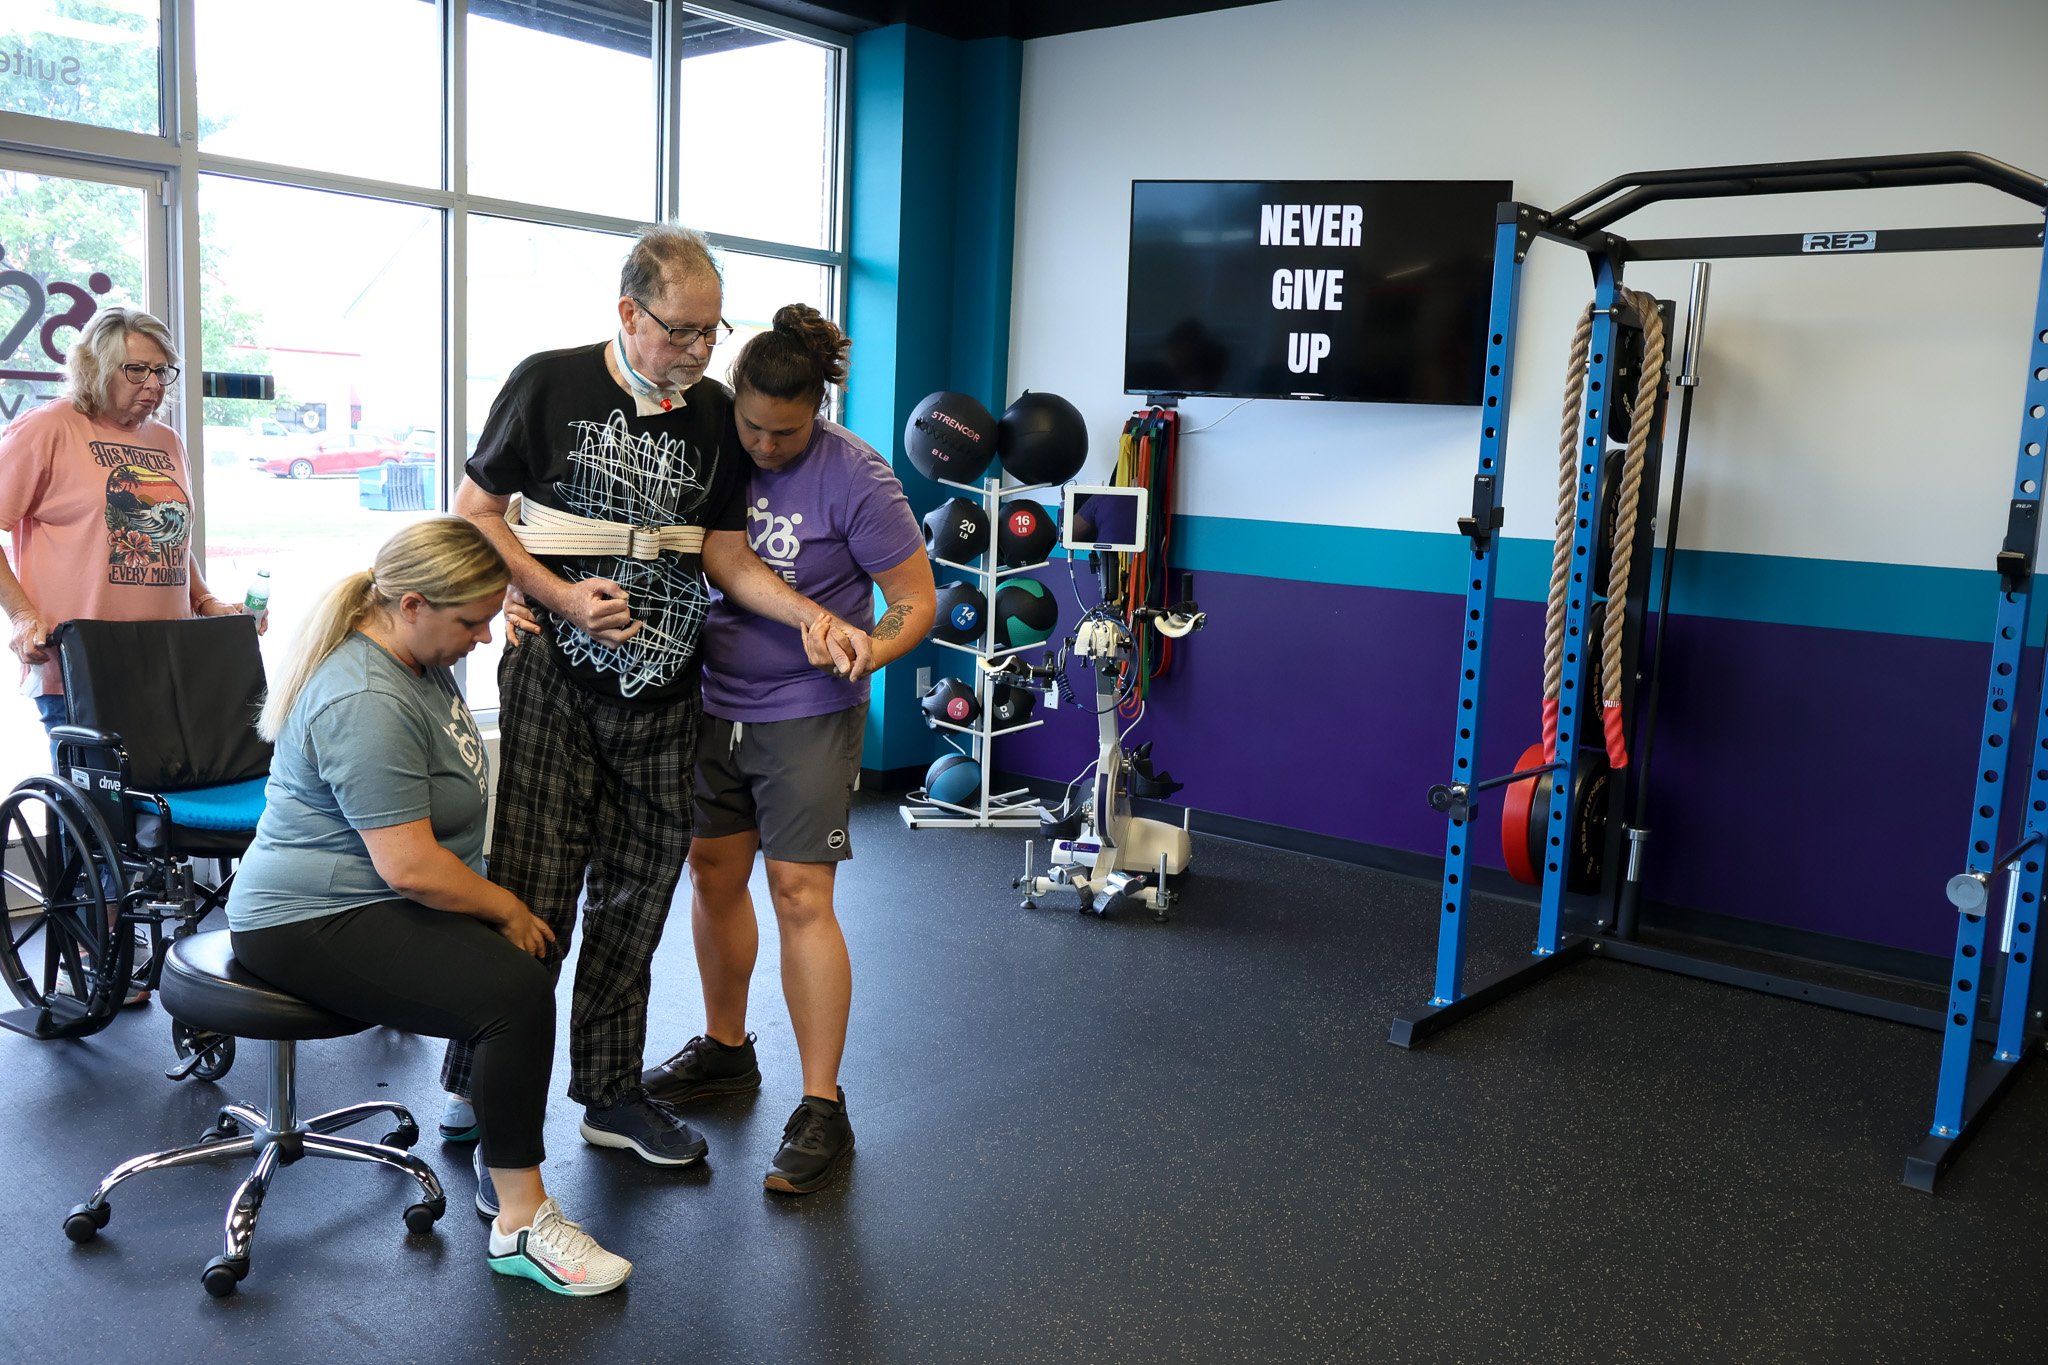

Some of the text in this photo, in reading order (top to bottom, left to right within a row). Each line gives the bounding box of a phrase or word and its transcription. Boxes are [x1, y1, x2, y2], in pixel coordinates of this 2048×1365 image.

[1259, 204, 1363, 247] NEVER
[1810, 233, 1869, 250] REP
[1271, 268, 1344, 311] GIVE
[1287, 332, 1331, 374] UP
[931, 411, 980, 442] STRENCOR
[938, 452, 949, 462] LB
[959, 519, 976, 534] 20
[1015, 515, 1030, 526] 16
[959, 531, 969, 539] LB
[957, 616, 966, 626] LB
[962, 606, 975, 621] 14
[955, 701, 964, 711] 4
[99, 775, 121, 792] drive
